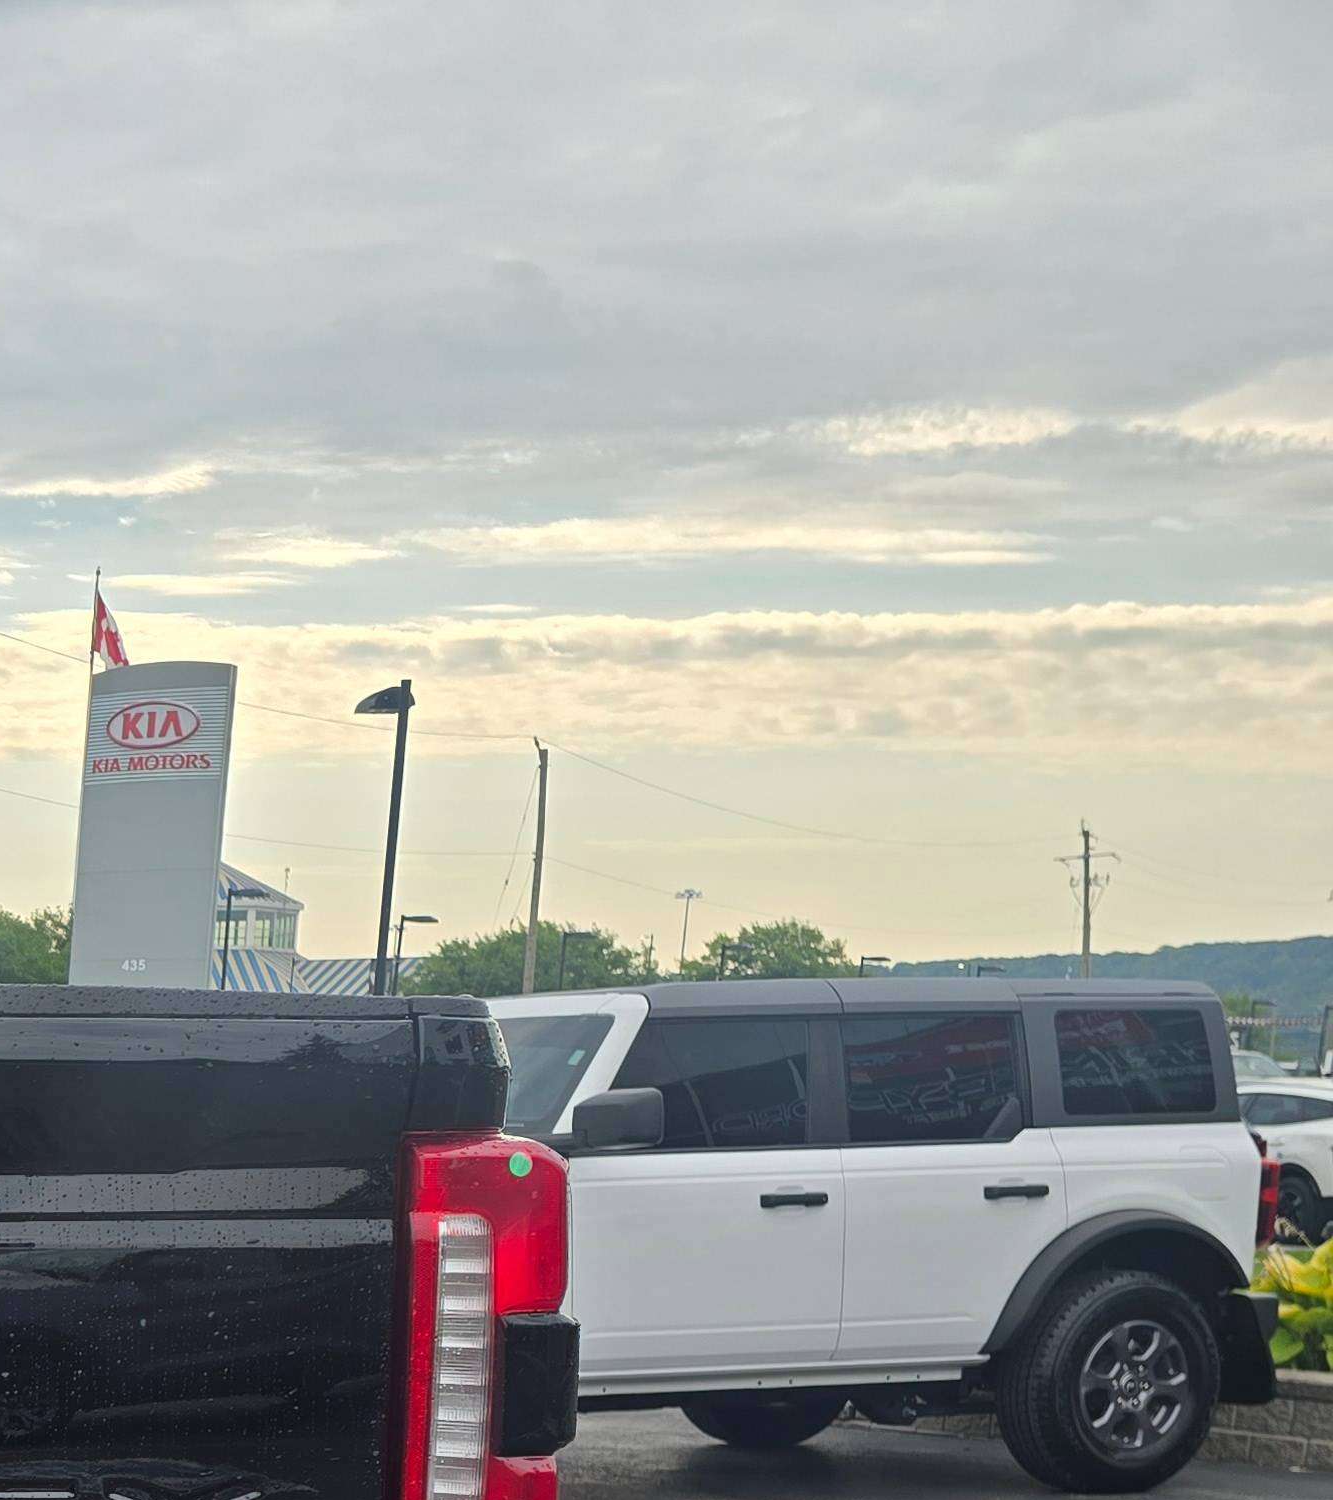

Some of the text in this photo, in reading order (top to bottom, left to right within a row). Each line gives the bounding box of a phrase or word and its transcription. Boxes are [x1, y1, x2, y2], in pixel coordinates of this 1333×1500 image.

[121, 710, 183, 740] KIA
[92, 753, 212, 774] KIA MOTORS
[121, 959, 146, 971] 435
